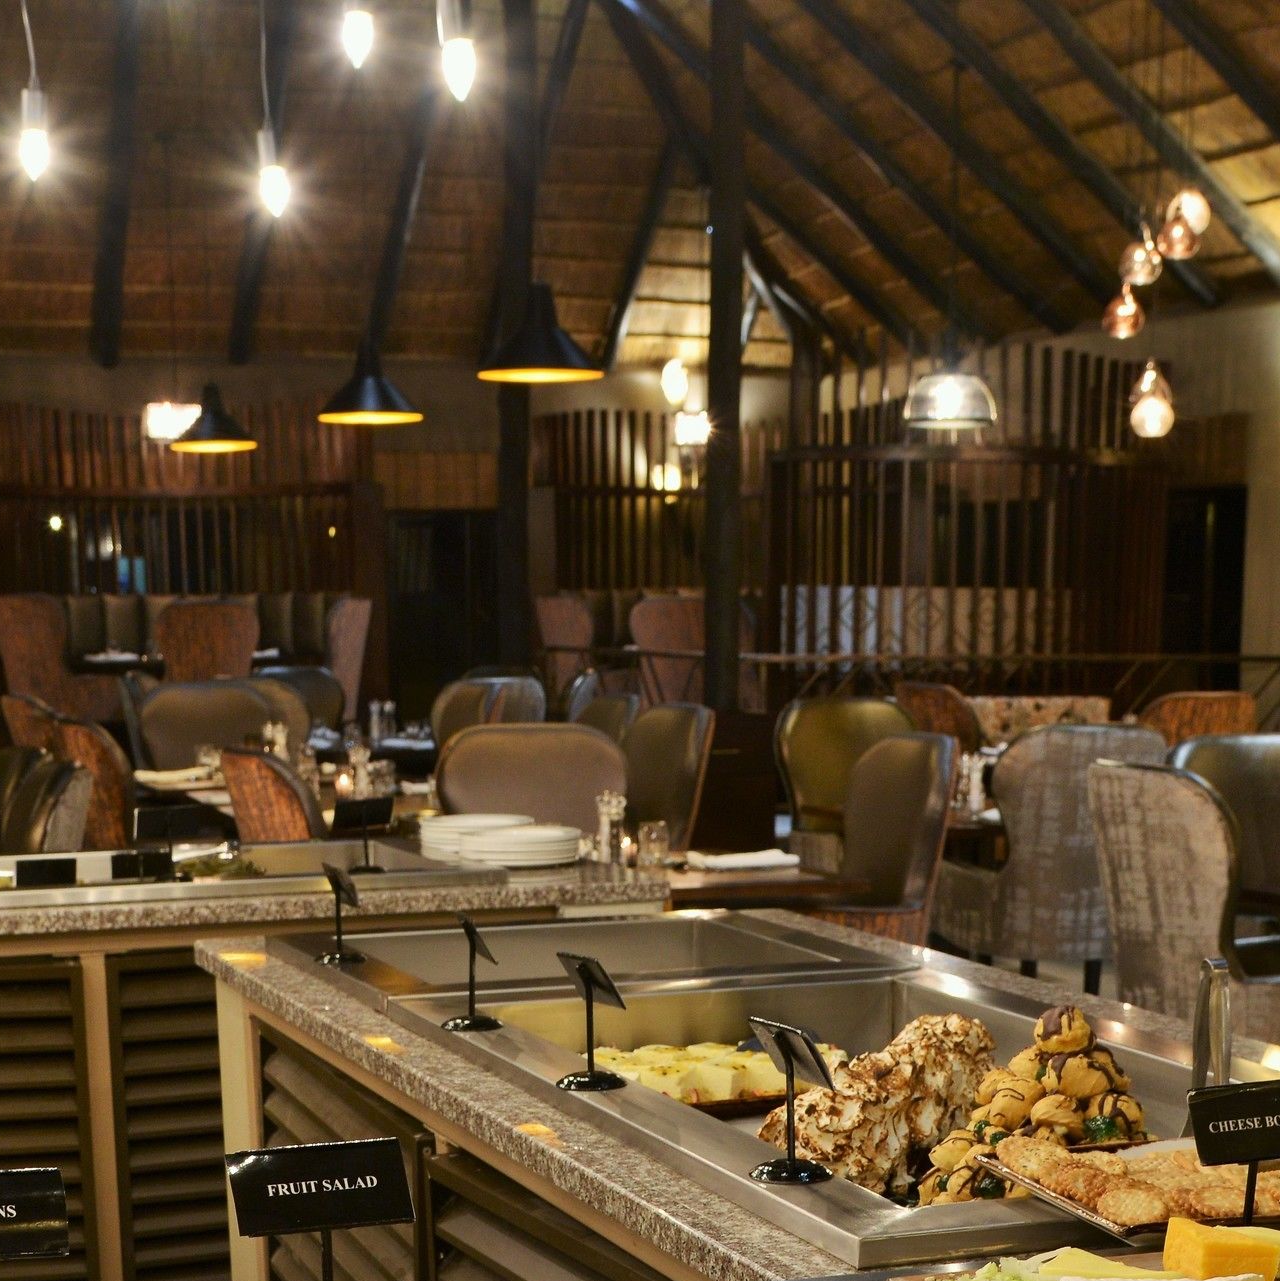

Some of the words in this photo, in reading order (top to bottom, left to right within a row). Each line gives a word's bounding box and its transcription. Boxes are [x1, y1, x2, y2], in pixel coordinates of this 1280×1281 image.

[1208, 1116, 1263, 1134] CHEESE
[267, 1180, 319, 1197] FRUIT
[322, 1175, 378, 1192] SALAD
